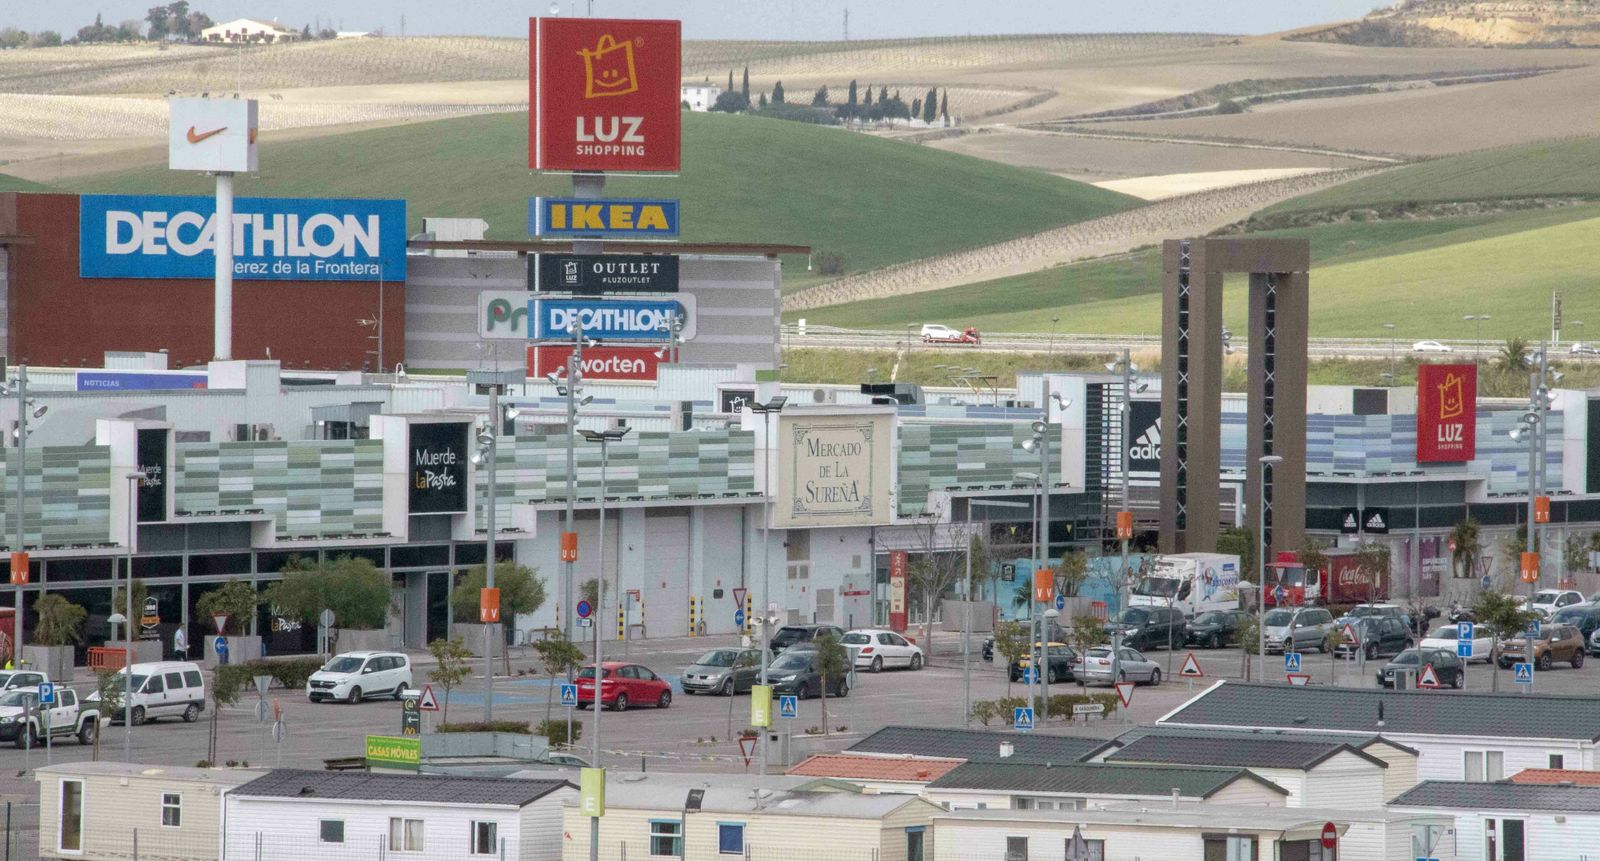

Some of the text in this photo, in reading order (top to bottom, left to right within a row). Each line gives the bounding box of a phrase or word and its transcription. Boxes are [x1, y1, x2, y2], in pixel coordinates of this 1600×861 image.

[576, 116, 645, 143] LUZ
[576, 145, 645, 156] SHOPPING
[551, 204, 669, 229] IKEA
[272, 260, 293, 275] de
[296, 260, 310, 275] la
[315, 260, 380, 275] Frontera
[593, 263, 659, 274] OUTLET
[550, 309, 672, 331] DECATHLON
[84, 379, 120, 387] NOTICIAS
[1438, 424, 1463, 442] LUZ
[807, 438, 862, 457] MERCADO
[416, 447, 456, 466] Muerde
[819, 465, 831, 478] DE
[806, 480, 860, 504] SUREÑA
[562, 549, 576, 558] U U
[21, 571, 26, 581] V
[1522, 570, 1537, 579] U U
[1037, 588, 1051, 598] V V
[481, 608, 497, 618] V V
[1461, 623, 1470, 638] P
[41, 685, 50, 701] P
[755, 710, 764, 721] E
[368, 745, 390, 757] CASAS
[585, 797, 594, 811] E
